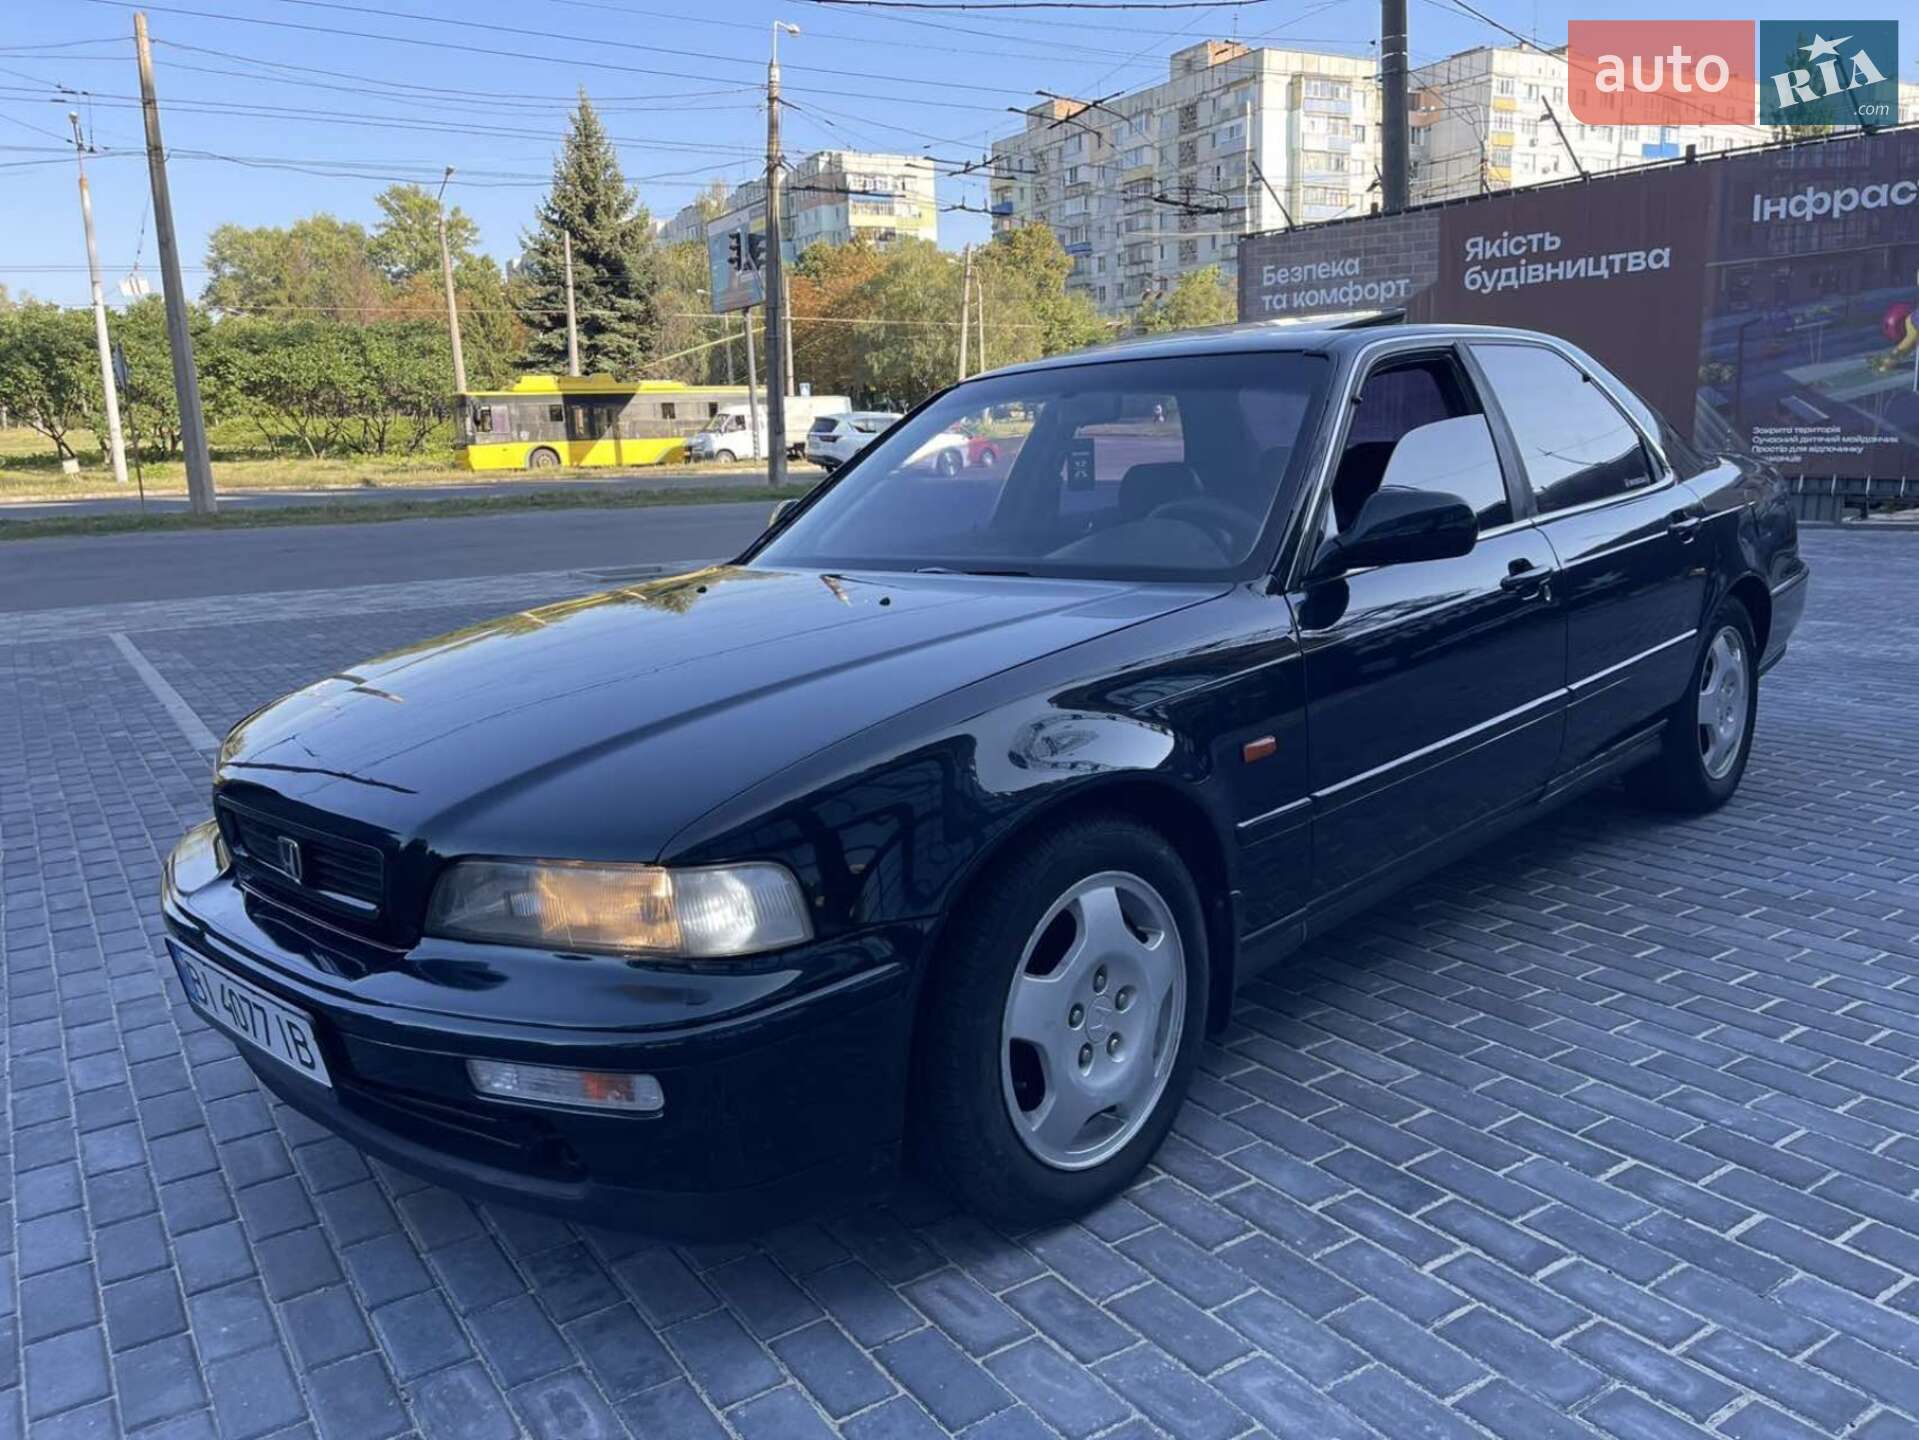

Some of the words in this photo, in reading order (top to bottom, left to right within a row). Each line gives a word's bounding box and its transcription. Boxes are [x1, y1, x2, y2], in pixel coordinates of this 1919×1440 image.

[1753, 180, 1919, 222] Інфрас
[1465, 231, 1561, 262] Якість
[1262, 257, 1360, 286] Безпека
[1464, 247, 1670, 294] будівництва
[1262, 292, 1287, 311] та
[1292, 278, 1410, 308] комфорт
[221, 983, 271, 1047] 4077
[276, 1013, 316, 1070] IB
